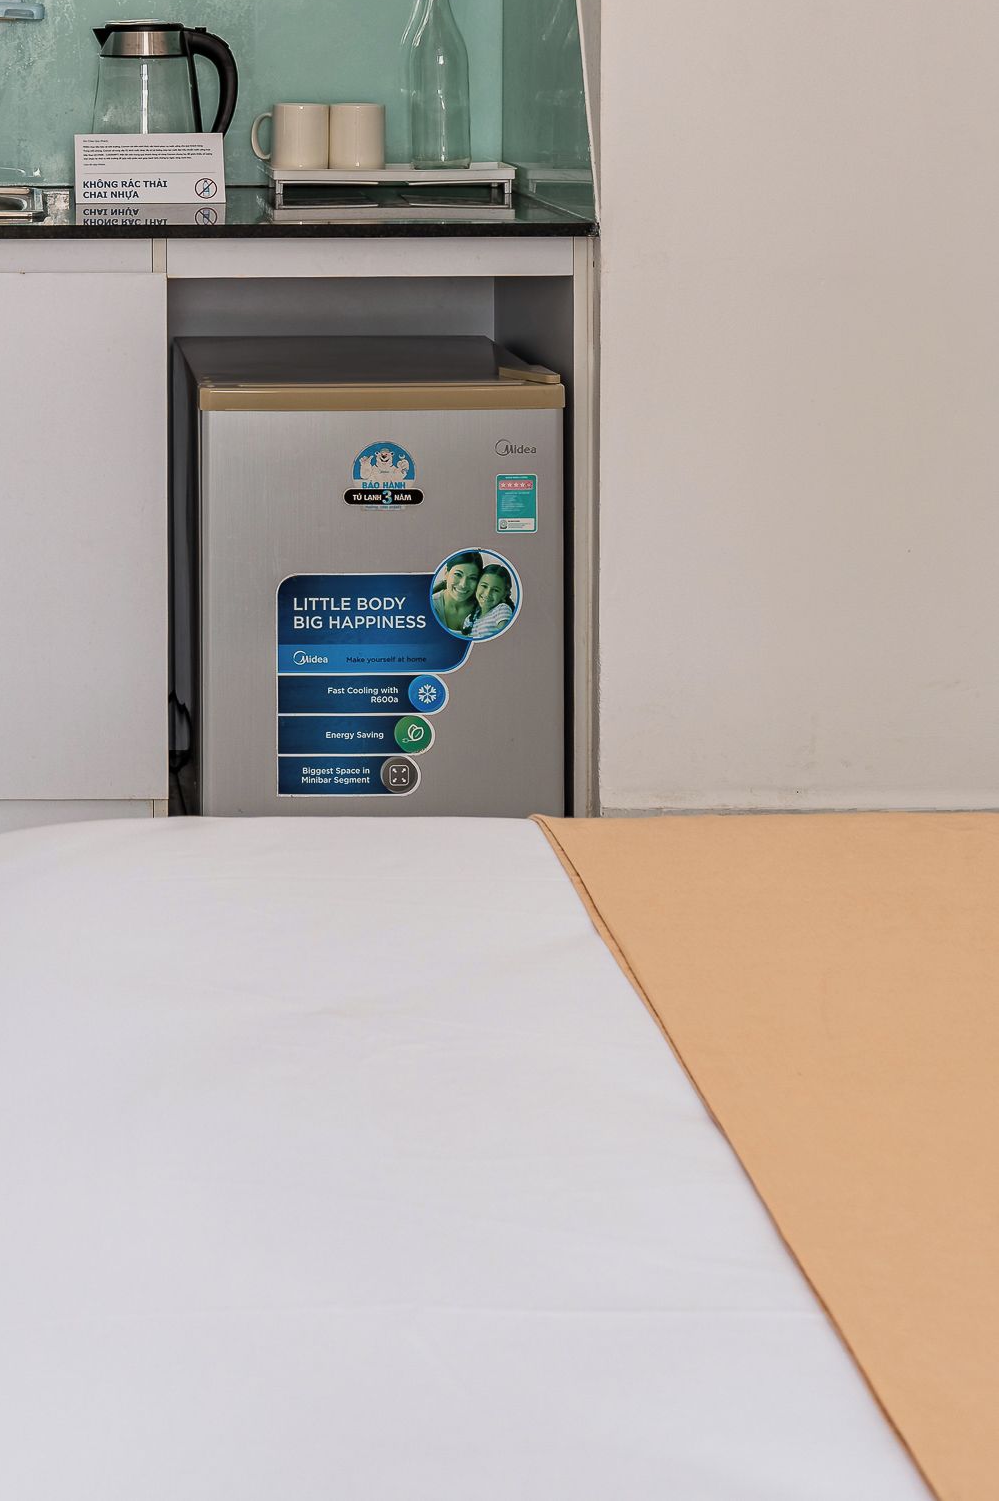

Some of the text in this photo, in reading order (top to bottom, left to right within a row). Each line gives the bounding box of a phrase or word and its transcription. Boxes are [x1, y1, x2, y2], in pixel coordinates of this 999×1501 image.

[83, 178, 168, 188] KHÔNG RÁC THẢI
[110, 191, 139, 200] NHỰA
[495, 439, 537, 456] Midea
[382, 490, 392, 504] 3
[294, 597, 406, 611] LITTLE BODY
[294, 615, 426, 629] BIG HAPPINESS
[293, 651, 328, 665] Midea
[367, 656, 396, 664] yourself
[347, 687, 378, 695] Cooling
[326, 731, 384, 740] Energy Saving
[302, 767, 333, 775] Biggest
[336, 767, 360, 775] Space
